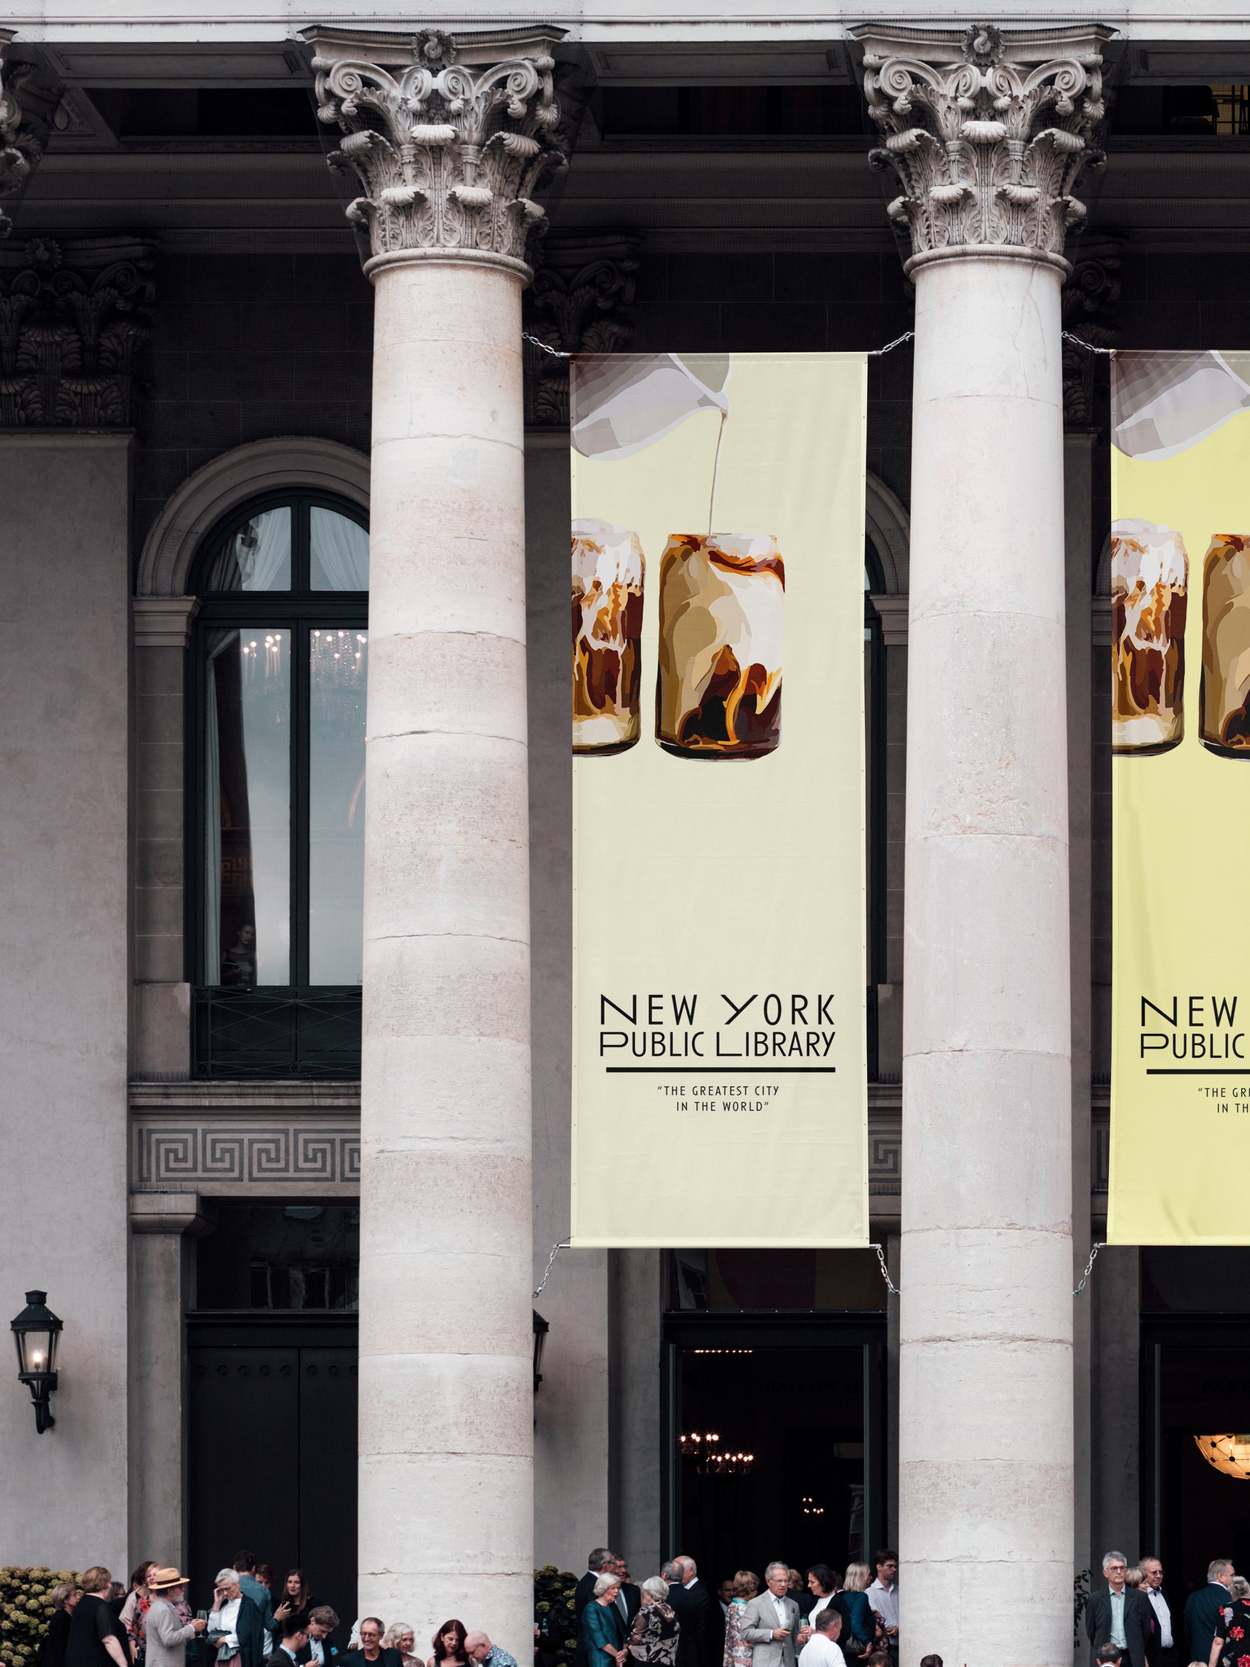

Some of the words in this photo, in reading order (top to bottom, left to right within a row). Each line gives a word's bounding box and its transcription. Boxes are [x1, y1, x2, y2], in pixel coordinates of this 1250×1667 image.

[600, 993, 698, 1026] NEW
[720, 993, 835, 1026] YORK
[1140, 995, 1238, 1028] NEW
[599, 1031, 705, 1058] PUBLIC
[716, 1030, 836, 1057] LIBRARY
[1140, 1032, 1245, 1060] PUBLIC
[692, 1085, 749, 1096] GREATEST
[754, 1085, 779, 1096] CITY
[676, 1101, 688, 1112] IN
[694, 1101, 716, 1112] THE
[1217, 1103, 1229, 1113] IN
